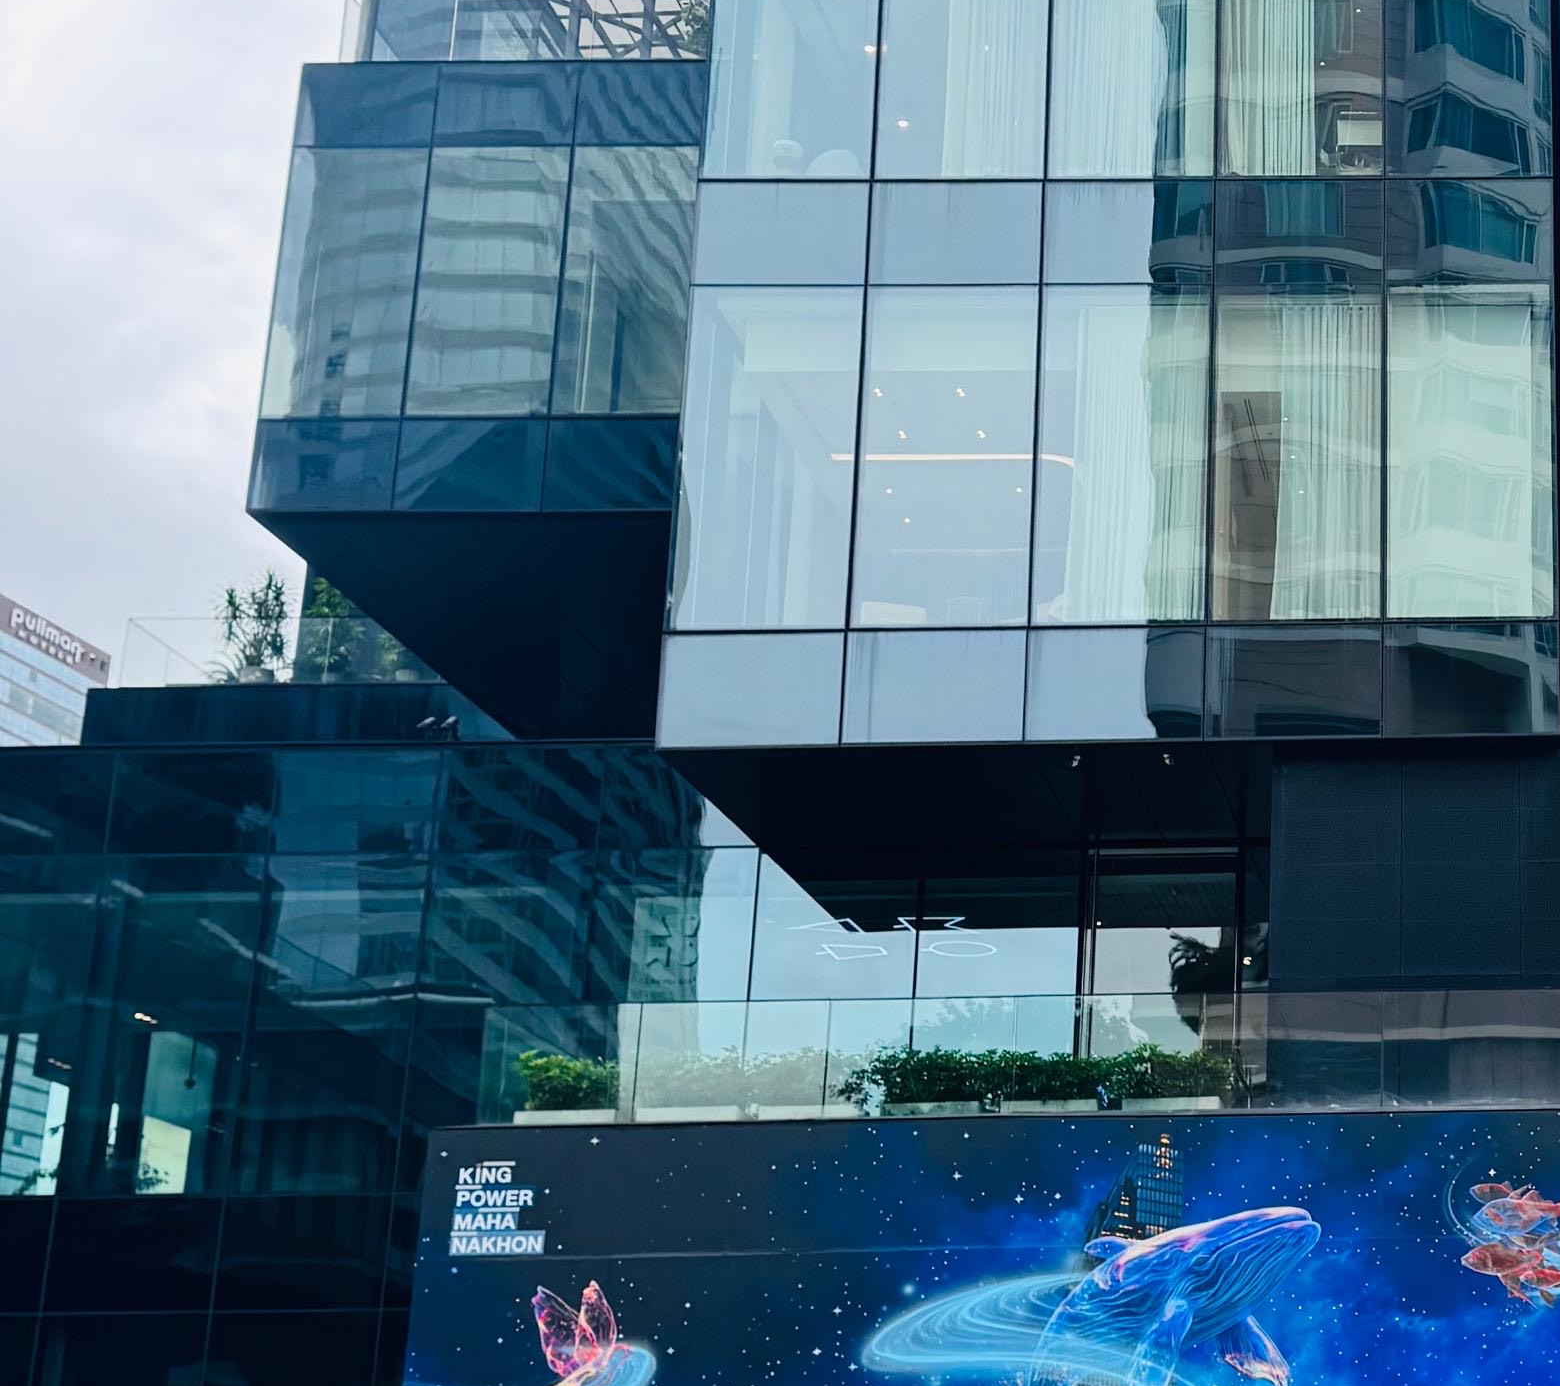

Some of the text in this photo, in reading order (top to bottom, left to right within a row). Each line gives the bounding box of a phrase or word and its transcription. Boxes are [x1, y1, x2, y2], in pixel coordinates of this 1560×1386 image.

[458, 1166, 512, 1184] KING
[456, 1189, 534, 1207] POWER
[453, 1213, 517, 1230] MAHA
[451, 1235, 543, 1253] NAKHON
